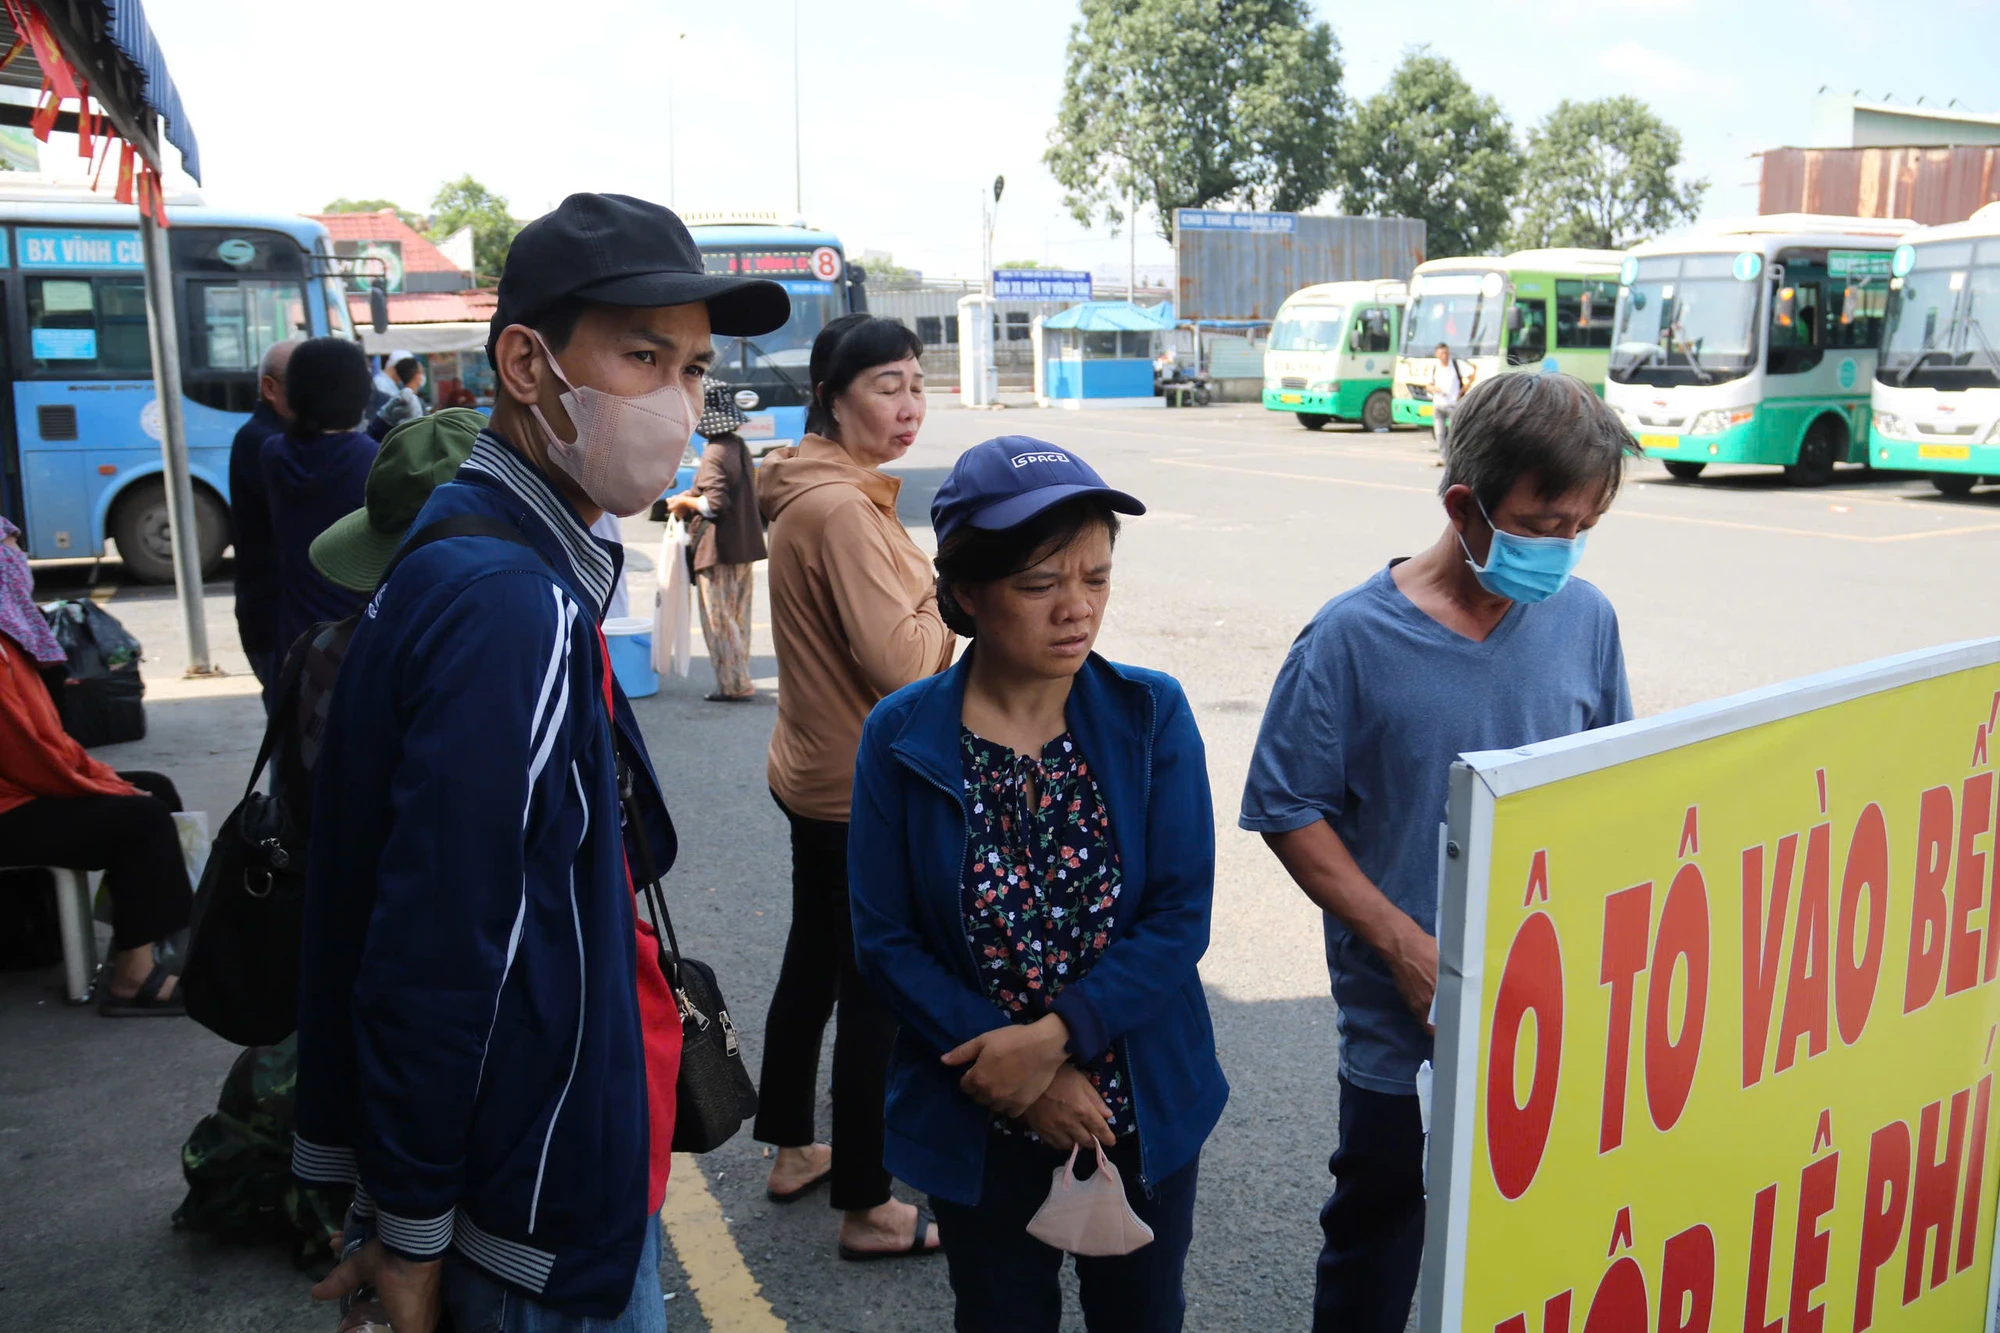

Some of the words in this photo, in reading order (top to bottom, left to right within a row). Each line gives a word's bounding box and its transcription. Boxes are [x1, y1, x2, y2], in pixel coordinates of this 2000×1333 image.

[26, 238, 57, 262] BX
[818, 252, 835, 276] 8
[1486, 849, 1565, 1202] Ô
[1598, 805, 1711, 1156] TÔ
[1741, 767, 1889, 1091] VÀO
[1852, 1022, 1998, 1333] PHÍ
